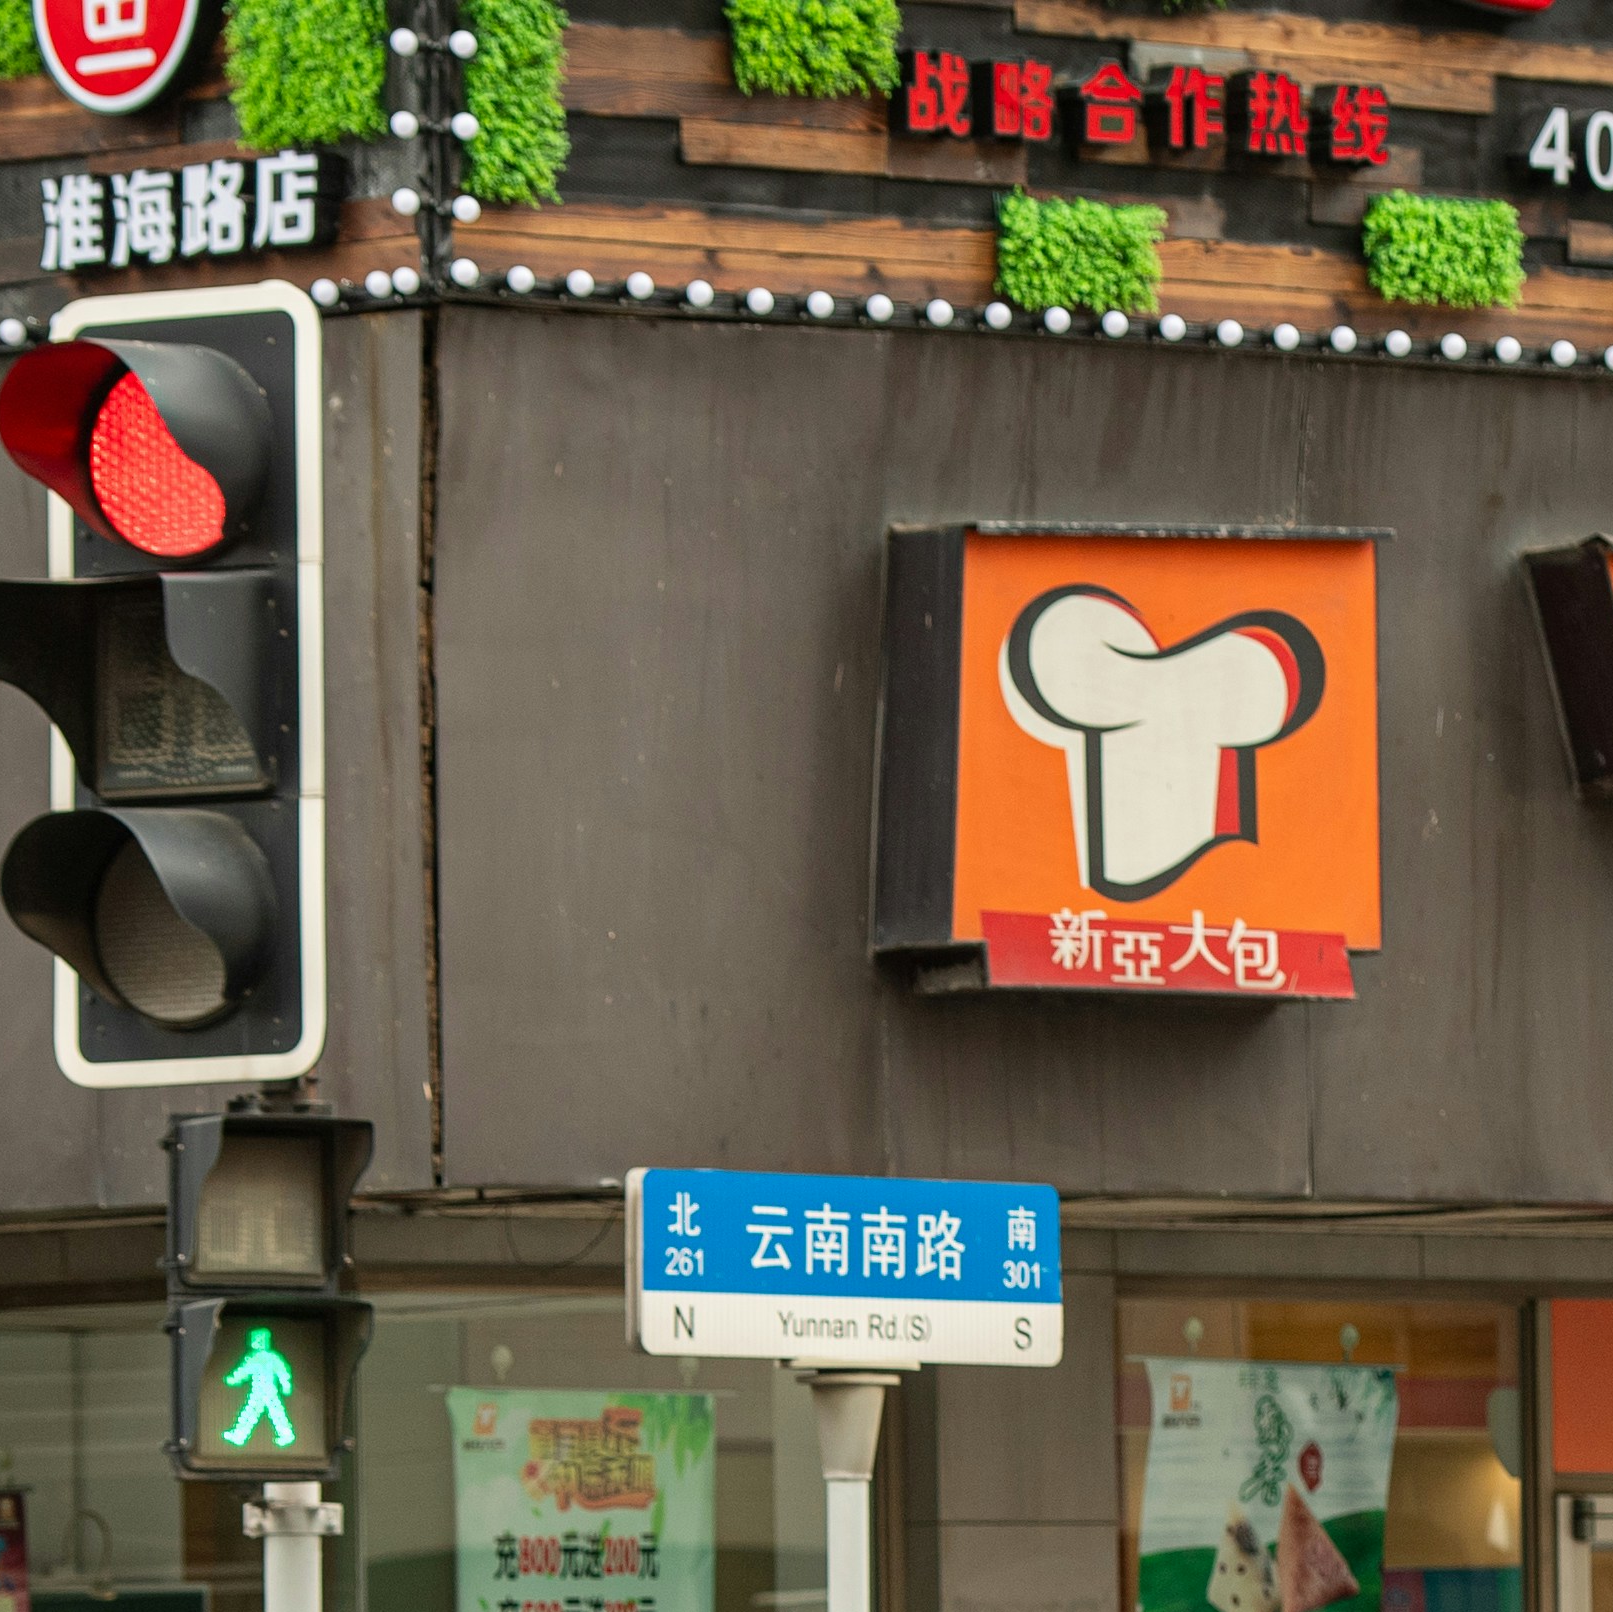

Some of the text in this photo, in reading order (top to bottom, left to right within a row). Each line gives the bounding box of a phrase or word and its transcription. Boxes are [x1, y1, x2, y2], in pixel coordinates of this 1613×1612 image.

[907, 50, 1389, 166] 战略合作热线
[40, 150, 319, 272] 淮海路店
[1049, 907, 1286, 990] 新亞大包
[668, 1192, 701, 1237] 北
[1007, 1206, 1037, 1251] 南
[665, 1247, 704, 1276] 261
[746, 1202, 966, 1281] 云南南路
[1003, 1261, 1041, 1289] 301
[674, 1306, 695, 1339] N
[778, 1311, 932, 1343] Yunnan Rd.(S)
[1014, 1317, 1033, 1350] S
